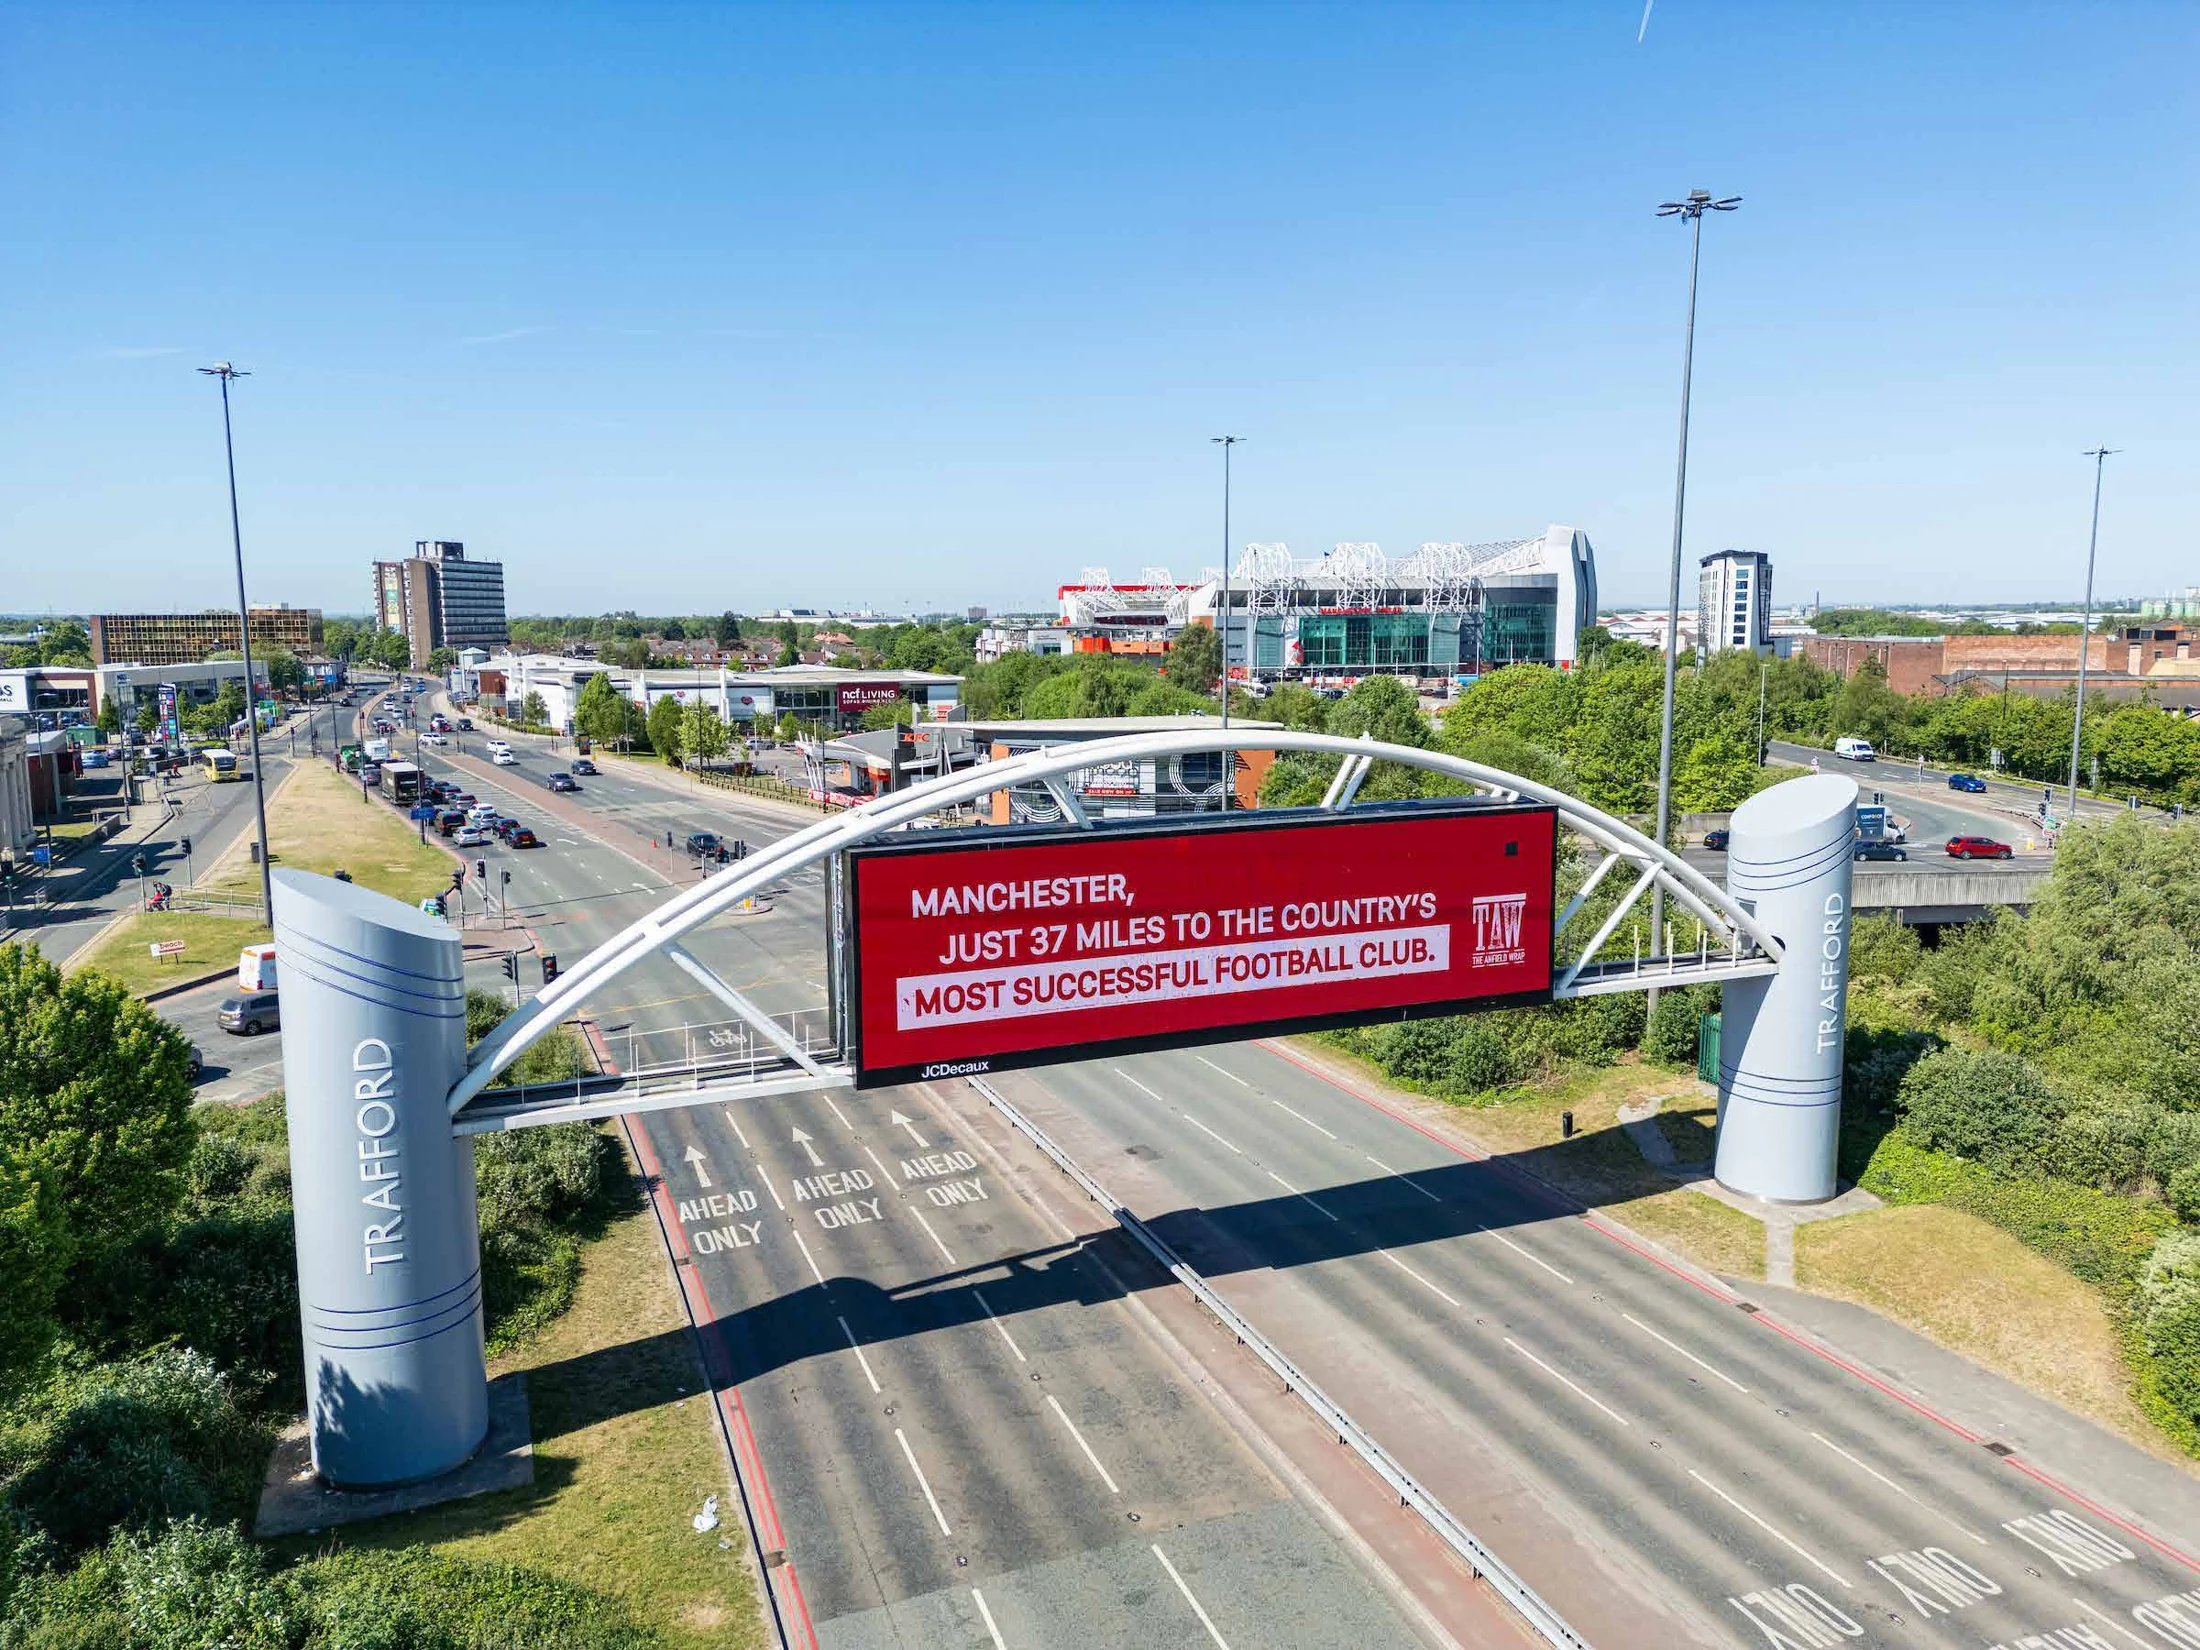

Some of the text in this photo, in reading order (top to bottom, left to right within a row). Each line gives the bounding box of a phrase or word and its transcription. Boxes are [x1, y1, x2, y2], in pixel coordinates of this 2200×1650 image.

[842, 688, 895, 699] ncf LIVING
[903, 732, 931, 743] KFC
[911, 873, 1135, 919] MANCHESTER,
[939, 892, 1437, 965] JUST 37 MILES TO THE COUNTRY'S
[1472, 901, 1526, 952] TAW
[1472, 952, 1526, 965] THE ANFIELD WRAP
[1816, 892, 1844, 1055] TRAFFORD
[915, 938, 1436, 1017] MOST SUCCESSFUL FOOTBALL CLUB.
[921, 1061, 989, 1078] JCDecaux
[353, 1038, 404, 1275] TRAFFORD
[900, 1151, 978, 1180] AHEAD
[792, 1168, 874, 1201] AHEAD
[925, 1177, 989, 1207] ONLY
[679, 1189, 758, 1223] AHEAD
[814, 1197, 884, 1229] ONLY
[693, 1220, 762, 1255] ONLY
[2001, 1509, 2136, 1577] ONLY
[1866, 1546, 2003, 1618] ONLY
[1728, 1583, 1865, 1650] ONLY
